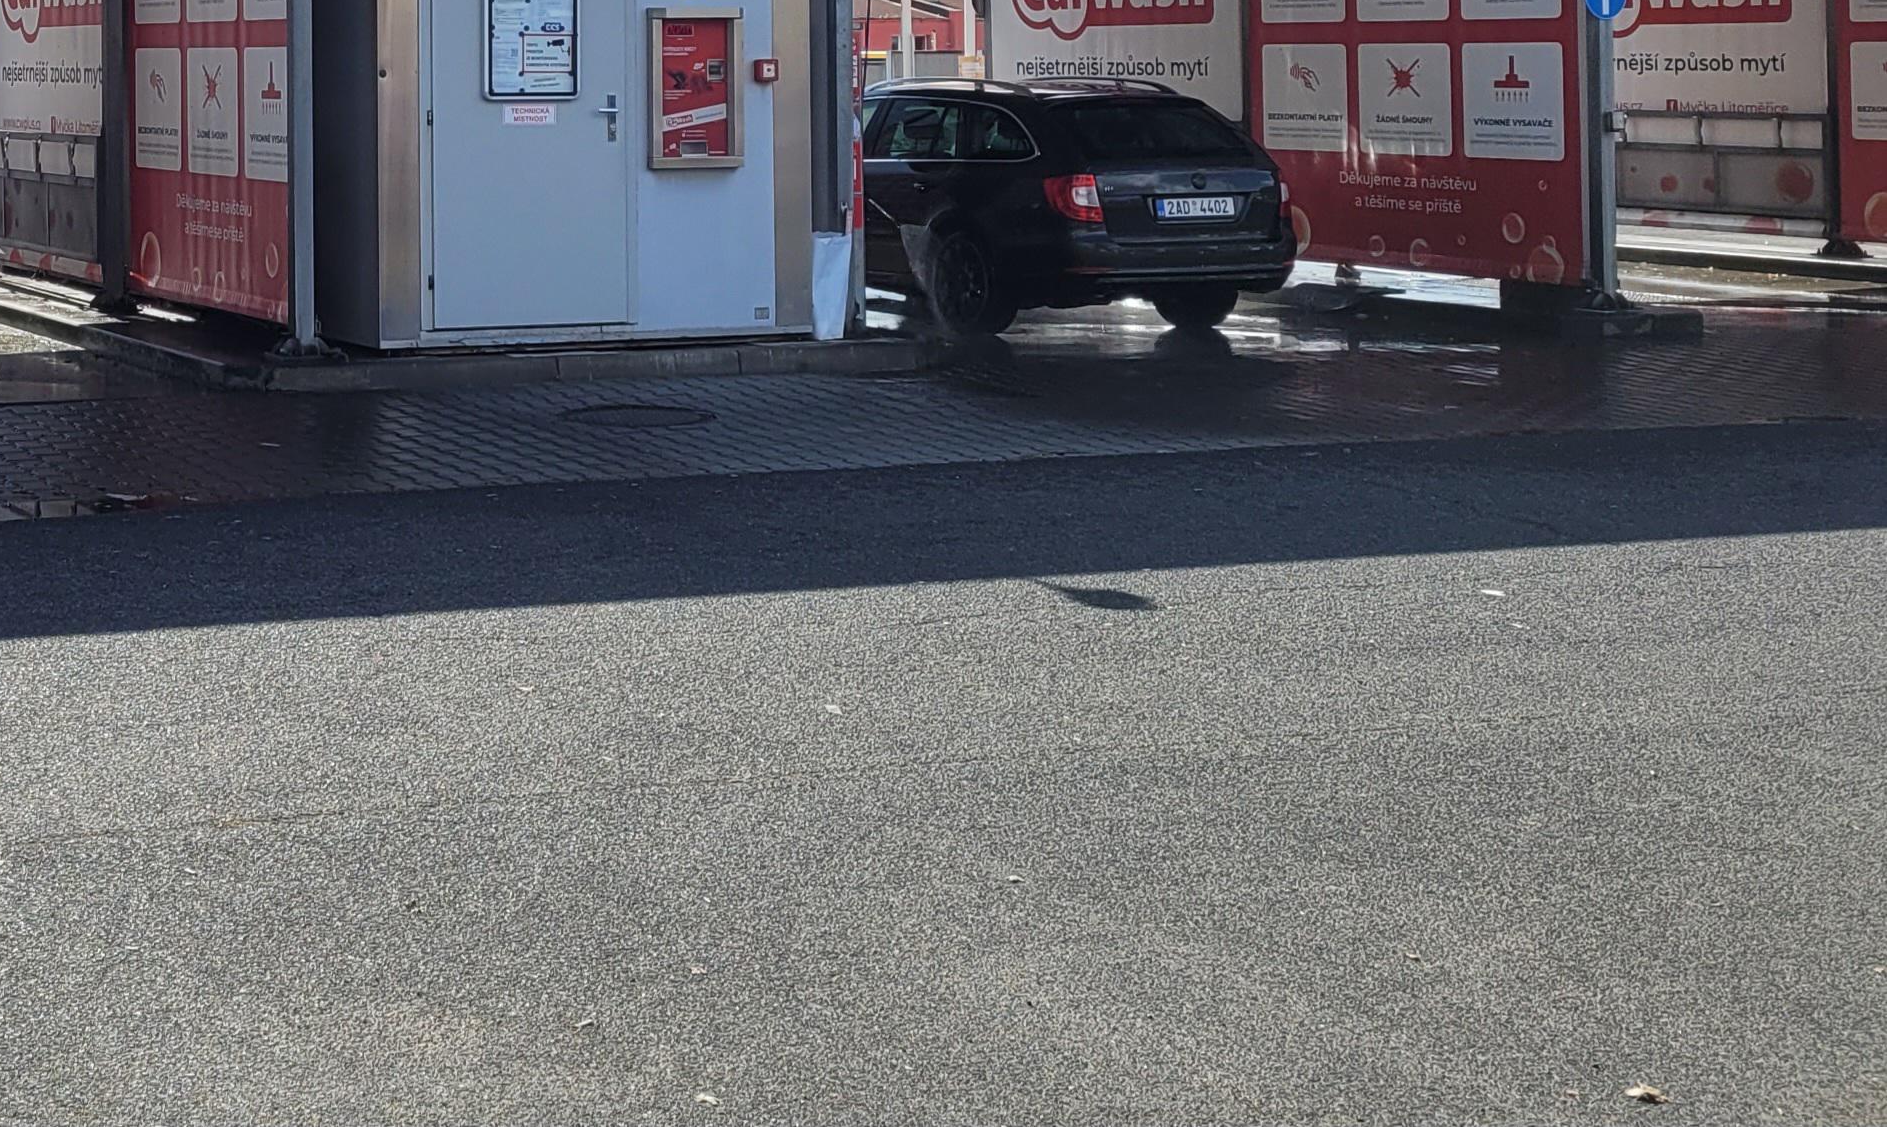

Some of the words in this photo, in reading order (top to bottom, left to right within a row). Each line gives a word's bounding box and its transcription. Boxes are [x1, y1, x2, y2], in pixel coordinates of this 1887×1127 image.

[1016, 56, 1103, 76] nejšetrnější
[1106, 55, 1166, 77] způsob
[1170, 56, 1210, 81] mytí
[1613, 53, 1659, 75] nější
[1664, 52, 1734, 75] způsob
[1740, 52, 1787, 76] mytí
[2, 60, 49, 88] nejšetrnější
[50, 60, 82, 88] způsob
[83, 65, 103, 89] myt
[511, 106, 550, 114] TECHNICKÁ
[1679, 100, 1717, 112] Myčka
[1857, 105, 1887, 113] BEZKON
[513, 114, 548, 123] MÍSTNOST
[1318, 114, 1343, 122] PLATBY
[1376, 114, 1400, 124] ŽÁDNÉ
[1473, 116, 1510, 127] VÝKONNÉ
[1512, 116, 1554, 128] VYSAVAČE
[1339, 171, 1401, 188] Děkujeme
[1403, 176, 1416, 187] za
[1420, 173, 1477, 191] návštěvu
[176, 193, 211, 213] Děkujeme
[220, 200, 252, 217] návštěvu
[1167, 201, 1191, 215] 2AD
[1200, 199, 1229, 214] 4402
[1354, 196, 1362, 207] a
[1364, 194, 1406, 209] těšíme
[1408, 200, 1423, 210] se
[1425, 197, 1462, 214] příště
